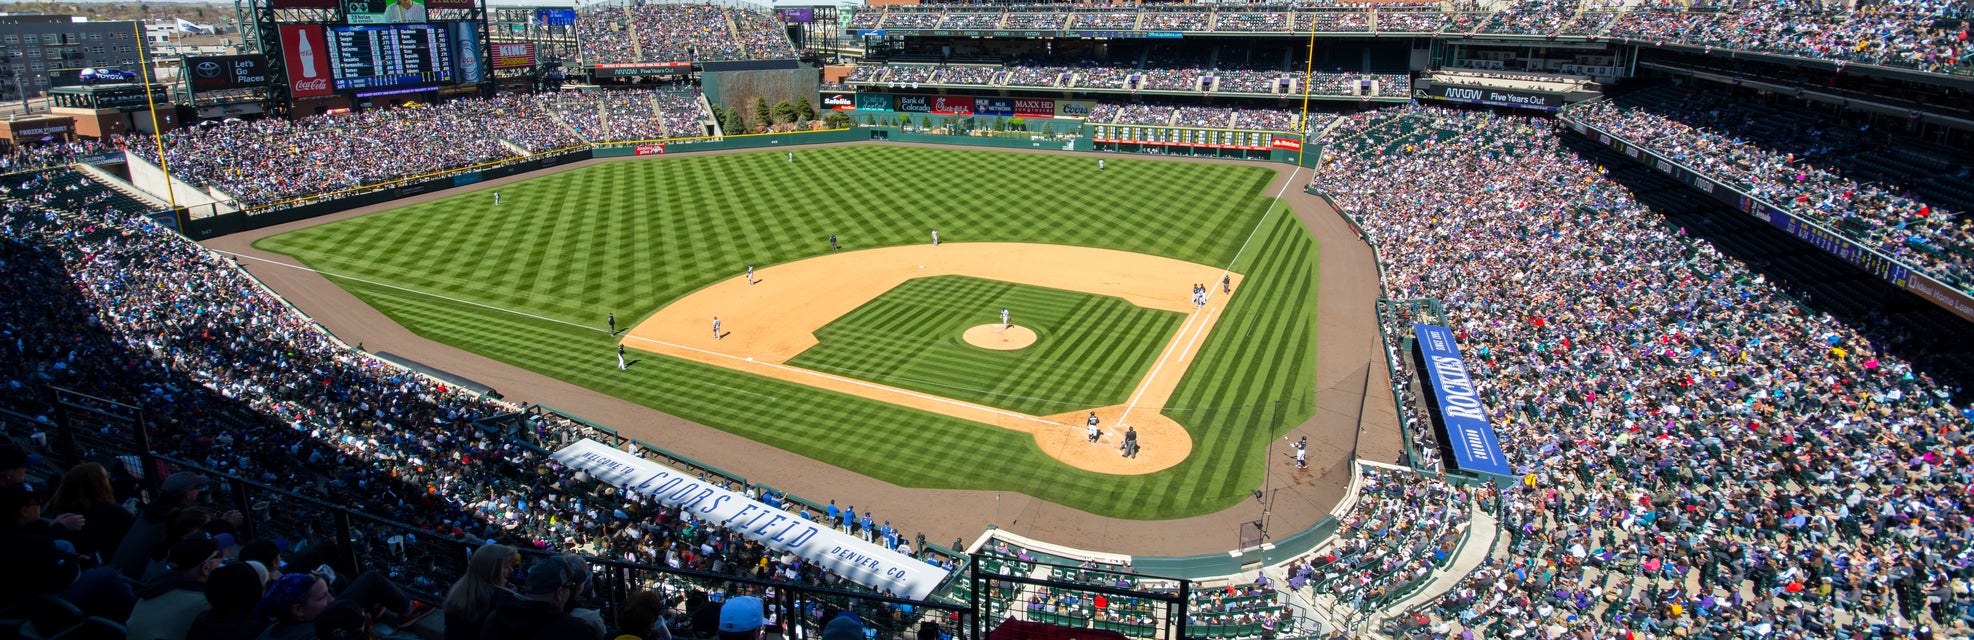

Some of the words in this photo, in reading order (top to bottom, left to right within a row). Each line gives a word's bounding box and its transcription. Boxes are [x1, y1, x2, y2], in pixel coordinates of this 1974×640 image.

[499, 44, 527, 56] KING
[296, 78, 327, 91] Coca-Cola
[1445, 88, 1482, 100] ARROW
[1491, 93, 1506, 101] Five
[1507, 94, 1528, 104] Years
[1530, 96, 1545, 105] Out
[1063, 103, 1088, 114] Coors
[1916, 282, 1934, 296] Ideal
[1933, 288, 1954, 306] Home
[1432, 355, 1486, 422] ROCKIES
[1466, 429, 1488, 460] COLORADO
[582, 452, 622, 469] WELCOME
[620, 466, 635, 474] TO
[638, 472, 731, 513] COORS
[726, 504, 818, 548] FIELD
[831, 546, 882, 572] DENVER,
[887, 566, 907, 581] CO.
